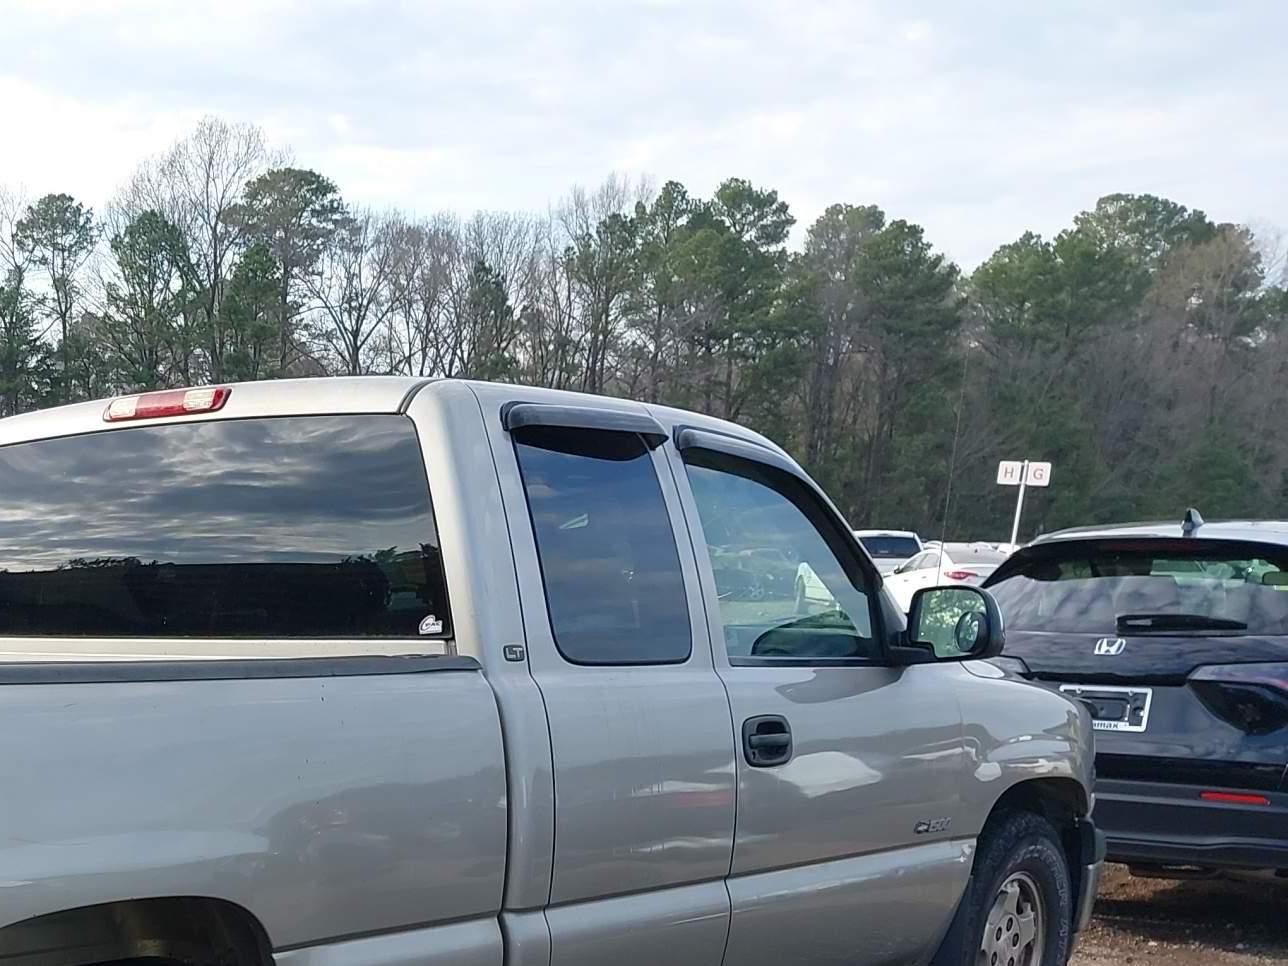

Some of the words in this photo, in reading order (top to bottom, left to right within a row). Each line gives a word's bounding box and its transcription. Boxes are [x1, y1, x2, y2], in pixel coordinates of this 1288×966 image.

[1004, 466, 1015, 479] H
[1033, 467, 1044, 480] G
[505, 647, 523, 659] LT
